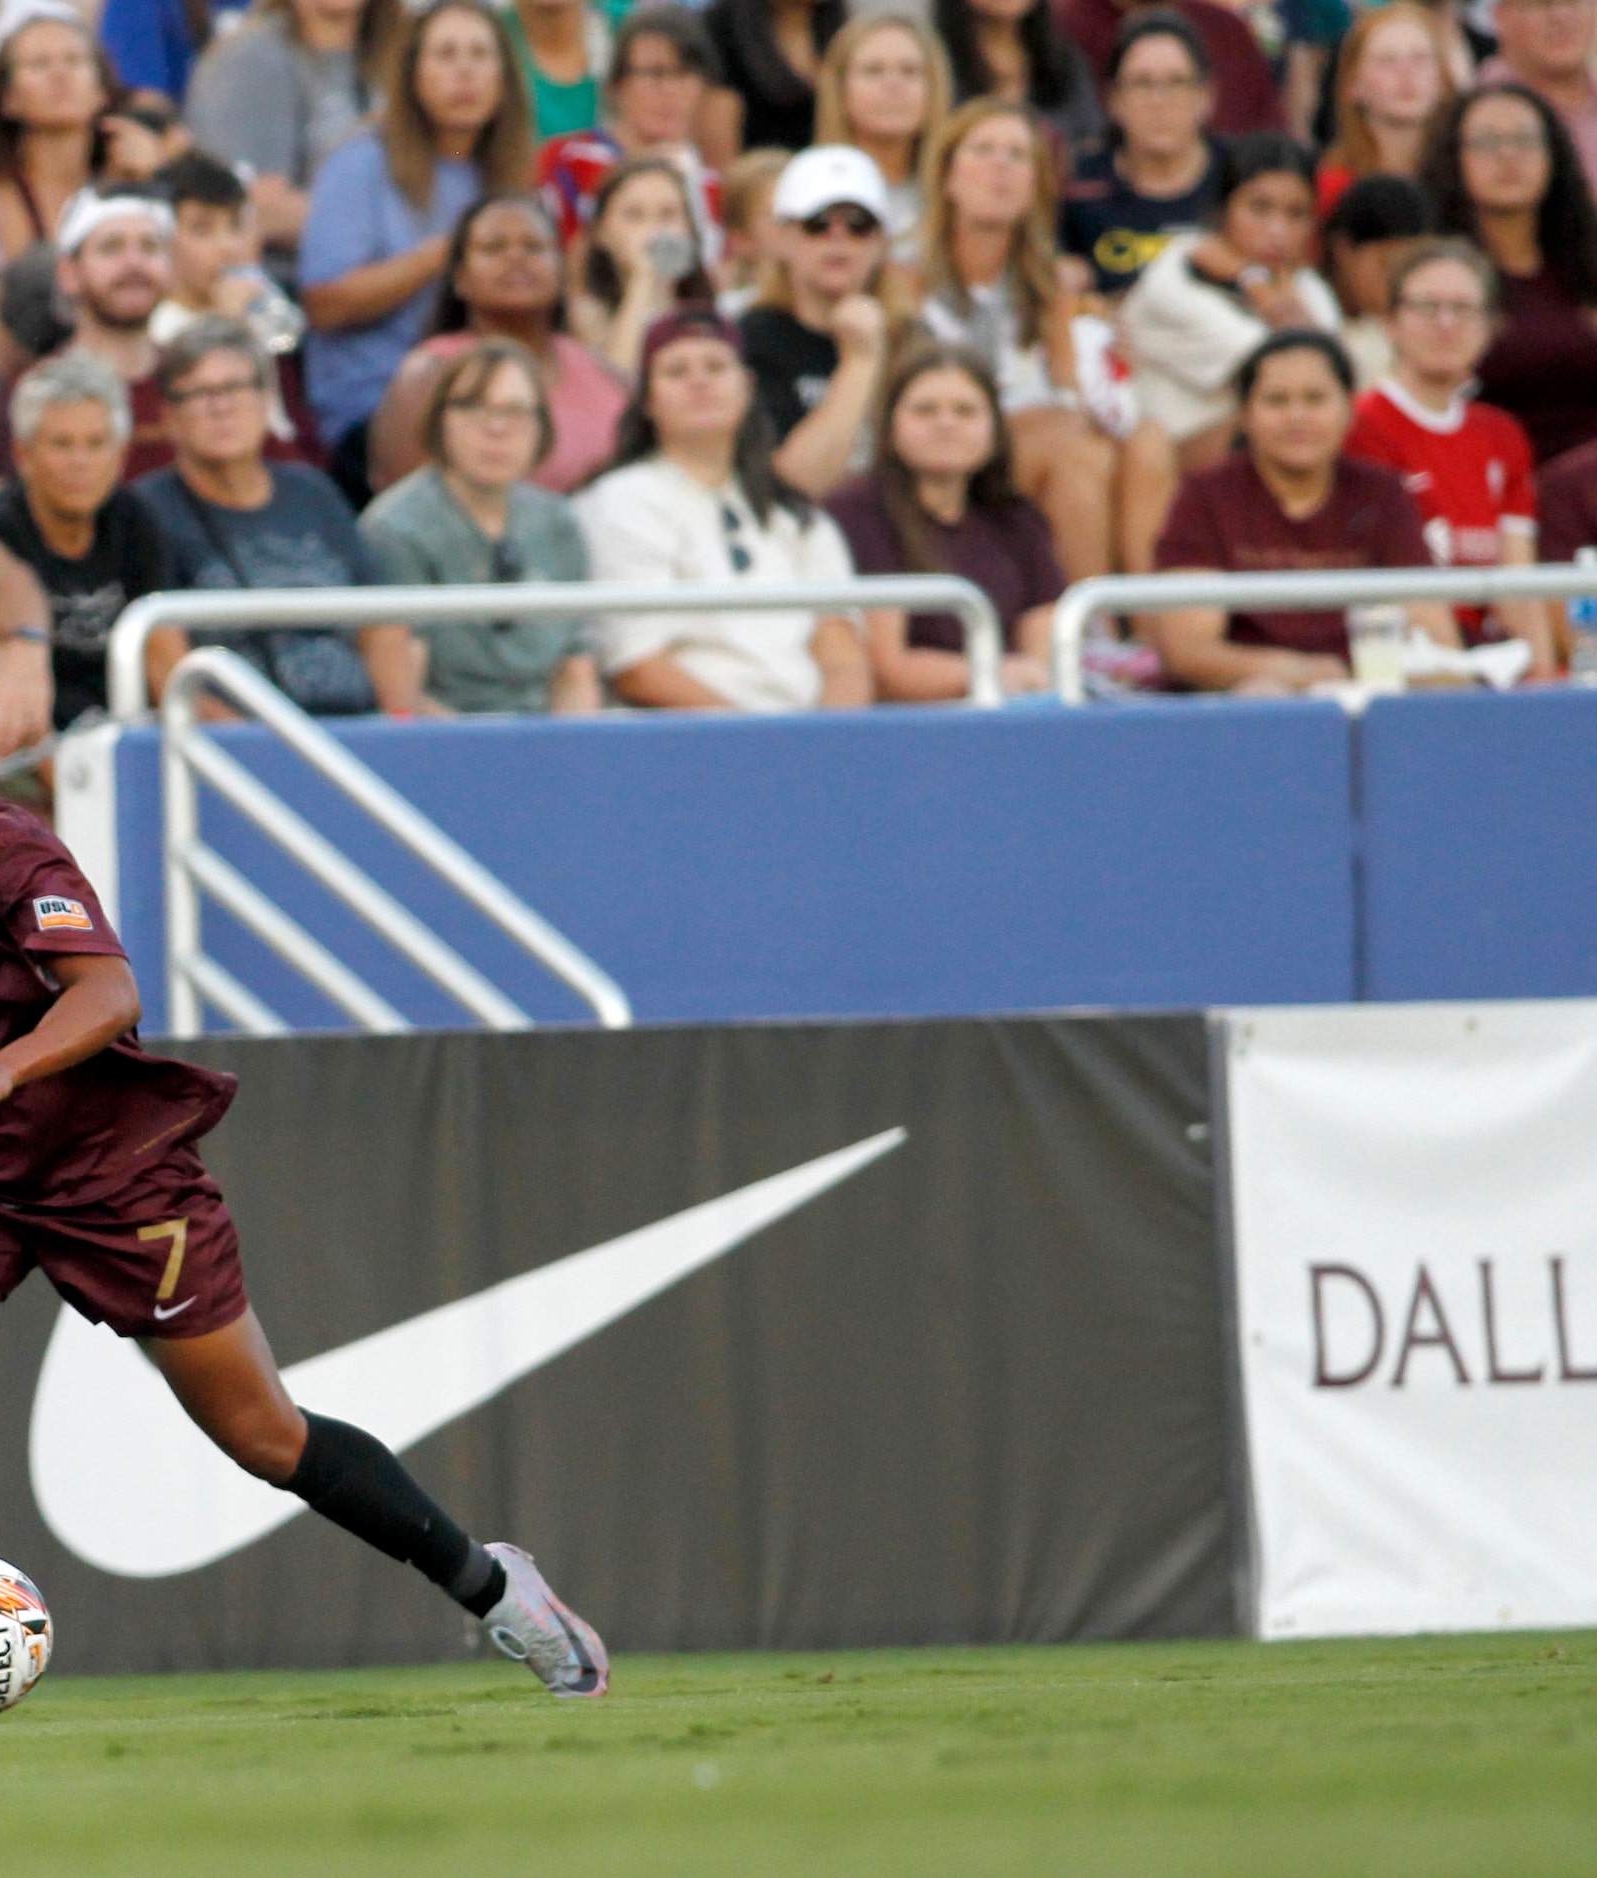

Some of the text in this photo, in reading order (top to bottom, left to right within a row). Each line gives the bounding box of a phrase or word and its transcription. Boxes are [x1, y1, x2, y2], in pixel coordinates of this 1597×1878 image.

[40, 901, 71, 914] USL
[137, 1216, 189, 1299] 7
[1308, 1256, 1597, 1388] DALL
